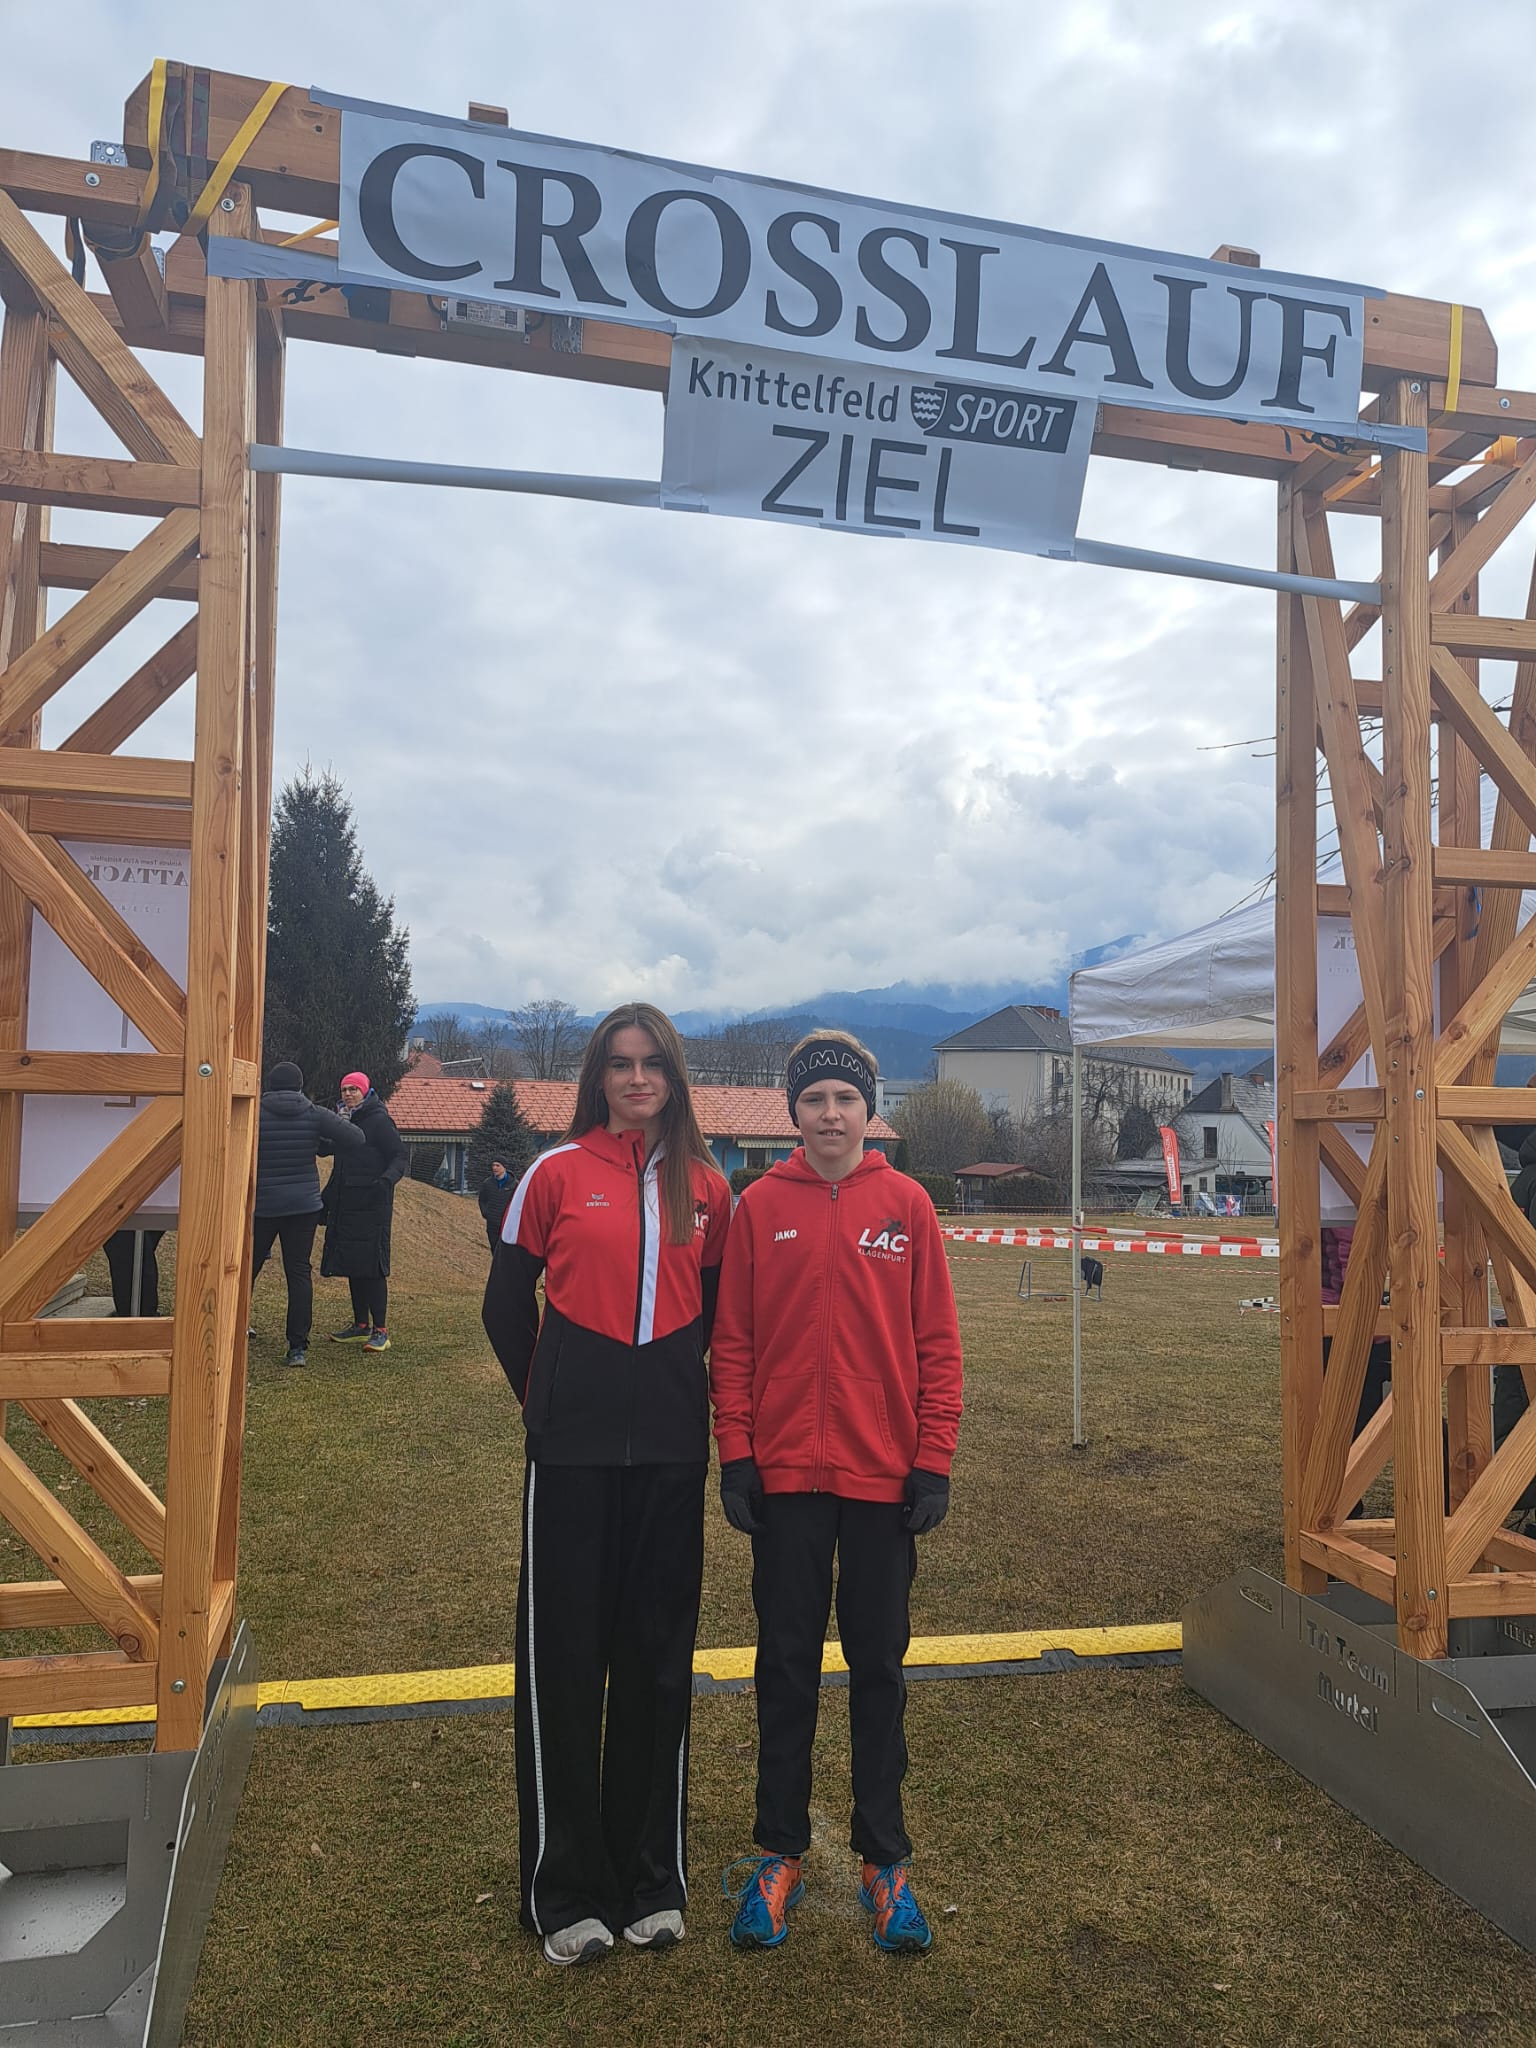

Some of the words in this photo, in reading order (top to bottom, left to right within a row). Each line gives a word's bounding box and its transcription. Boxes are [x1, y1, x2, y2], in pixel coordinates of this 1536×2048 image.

[359, 142, 1352, 413] CROSSLAUF
[689, 357, 899, 422] Knittelfeld
[949, 392, 1065, 444] SPORT
[761, 424, 980, 536] ZIEL
[789, 1049, 876, 1098] AMMU
[774, 1229, 798, 1242] JAKO
[857, 1248, 907, 1264] KLAGENFURT
[858, 1228, 910, 1253] LAC
[1306, 1618, 1330, 1657] Tri
[1336, 1636, 1390, 1695] Team
